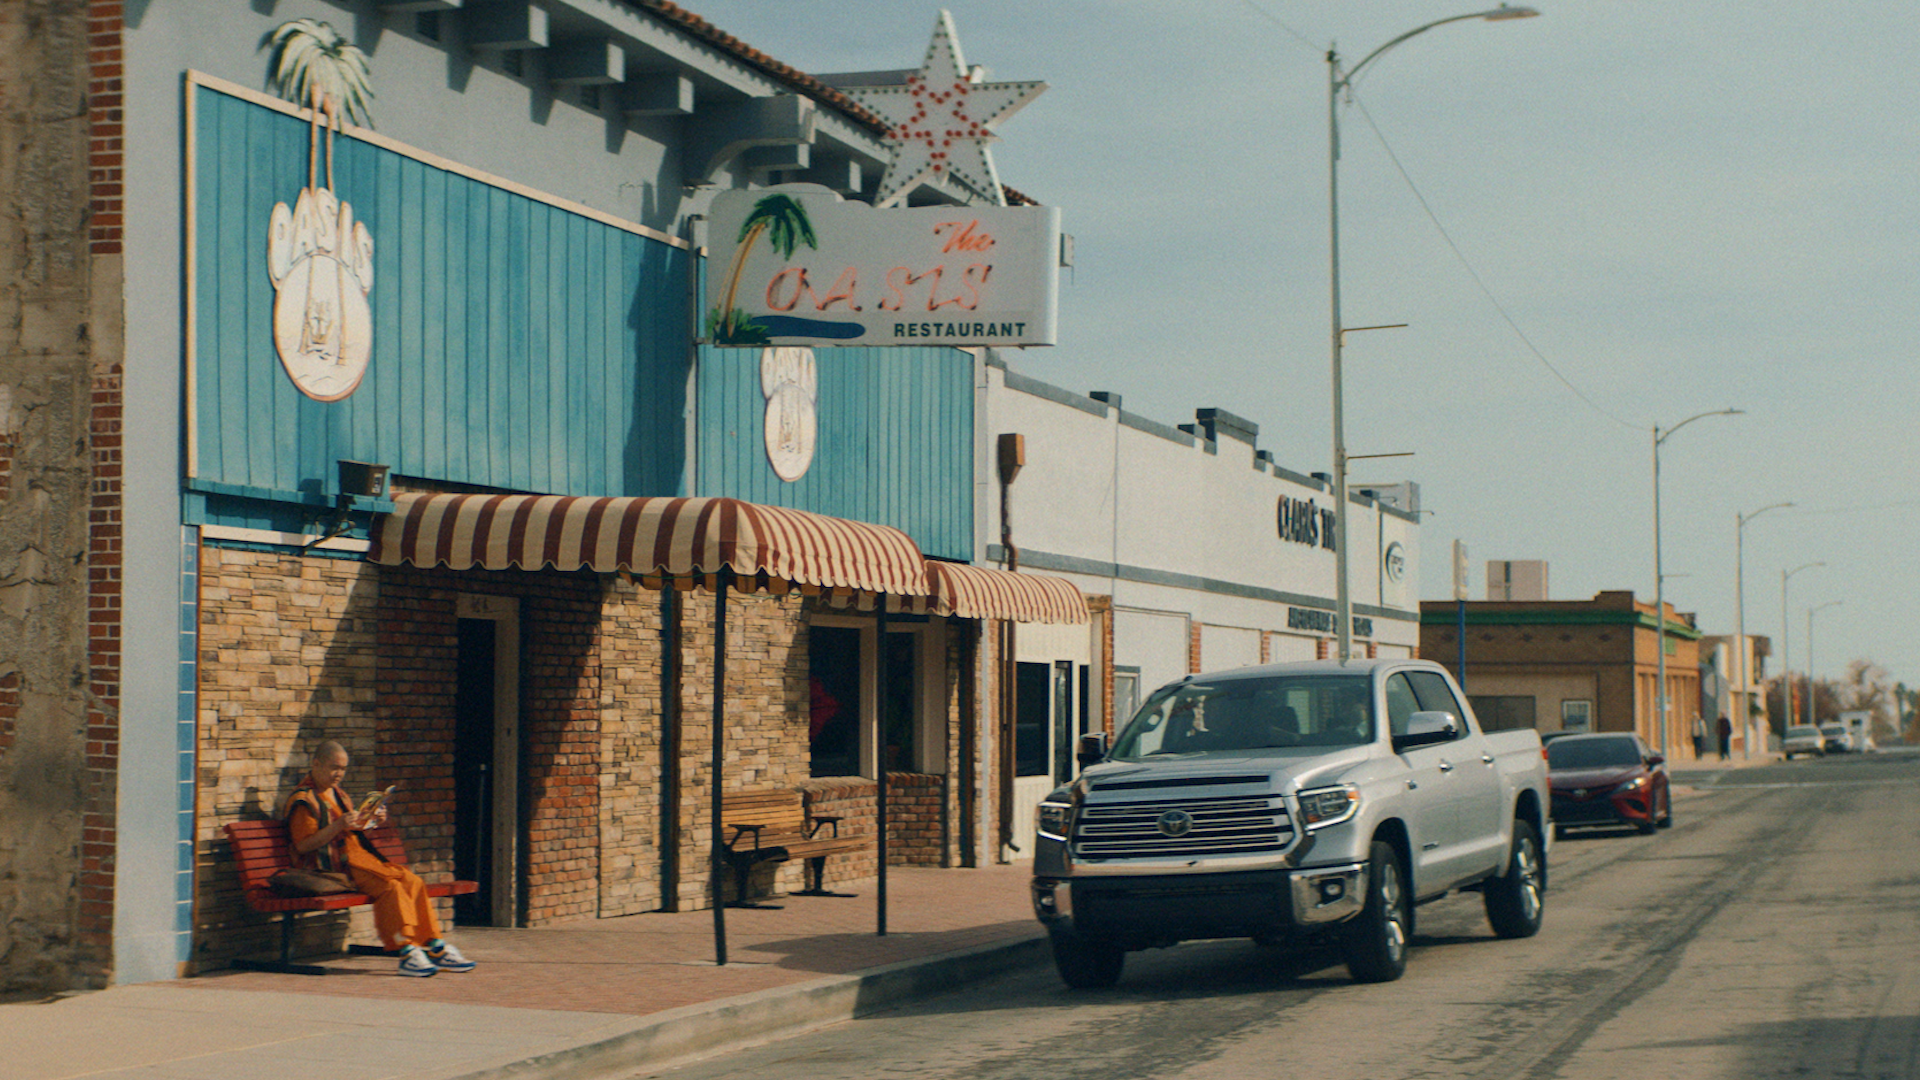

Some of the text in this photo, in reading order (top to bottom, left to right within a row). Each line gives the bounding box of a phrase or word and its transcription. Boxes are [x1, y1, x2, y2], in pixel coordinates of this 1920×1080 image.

[268, 187, 374, 293] OASIS
[934, 218, 996, 253] The
[766, 264, 993, 312] OASIS
[894, 322, 1026, 337] RESTAURANT
